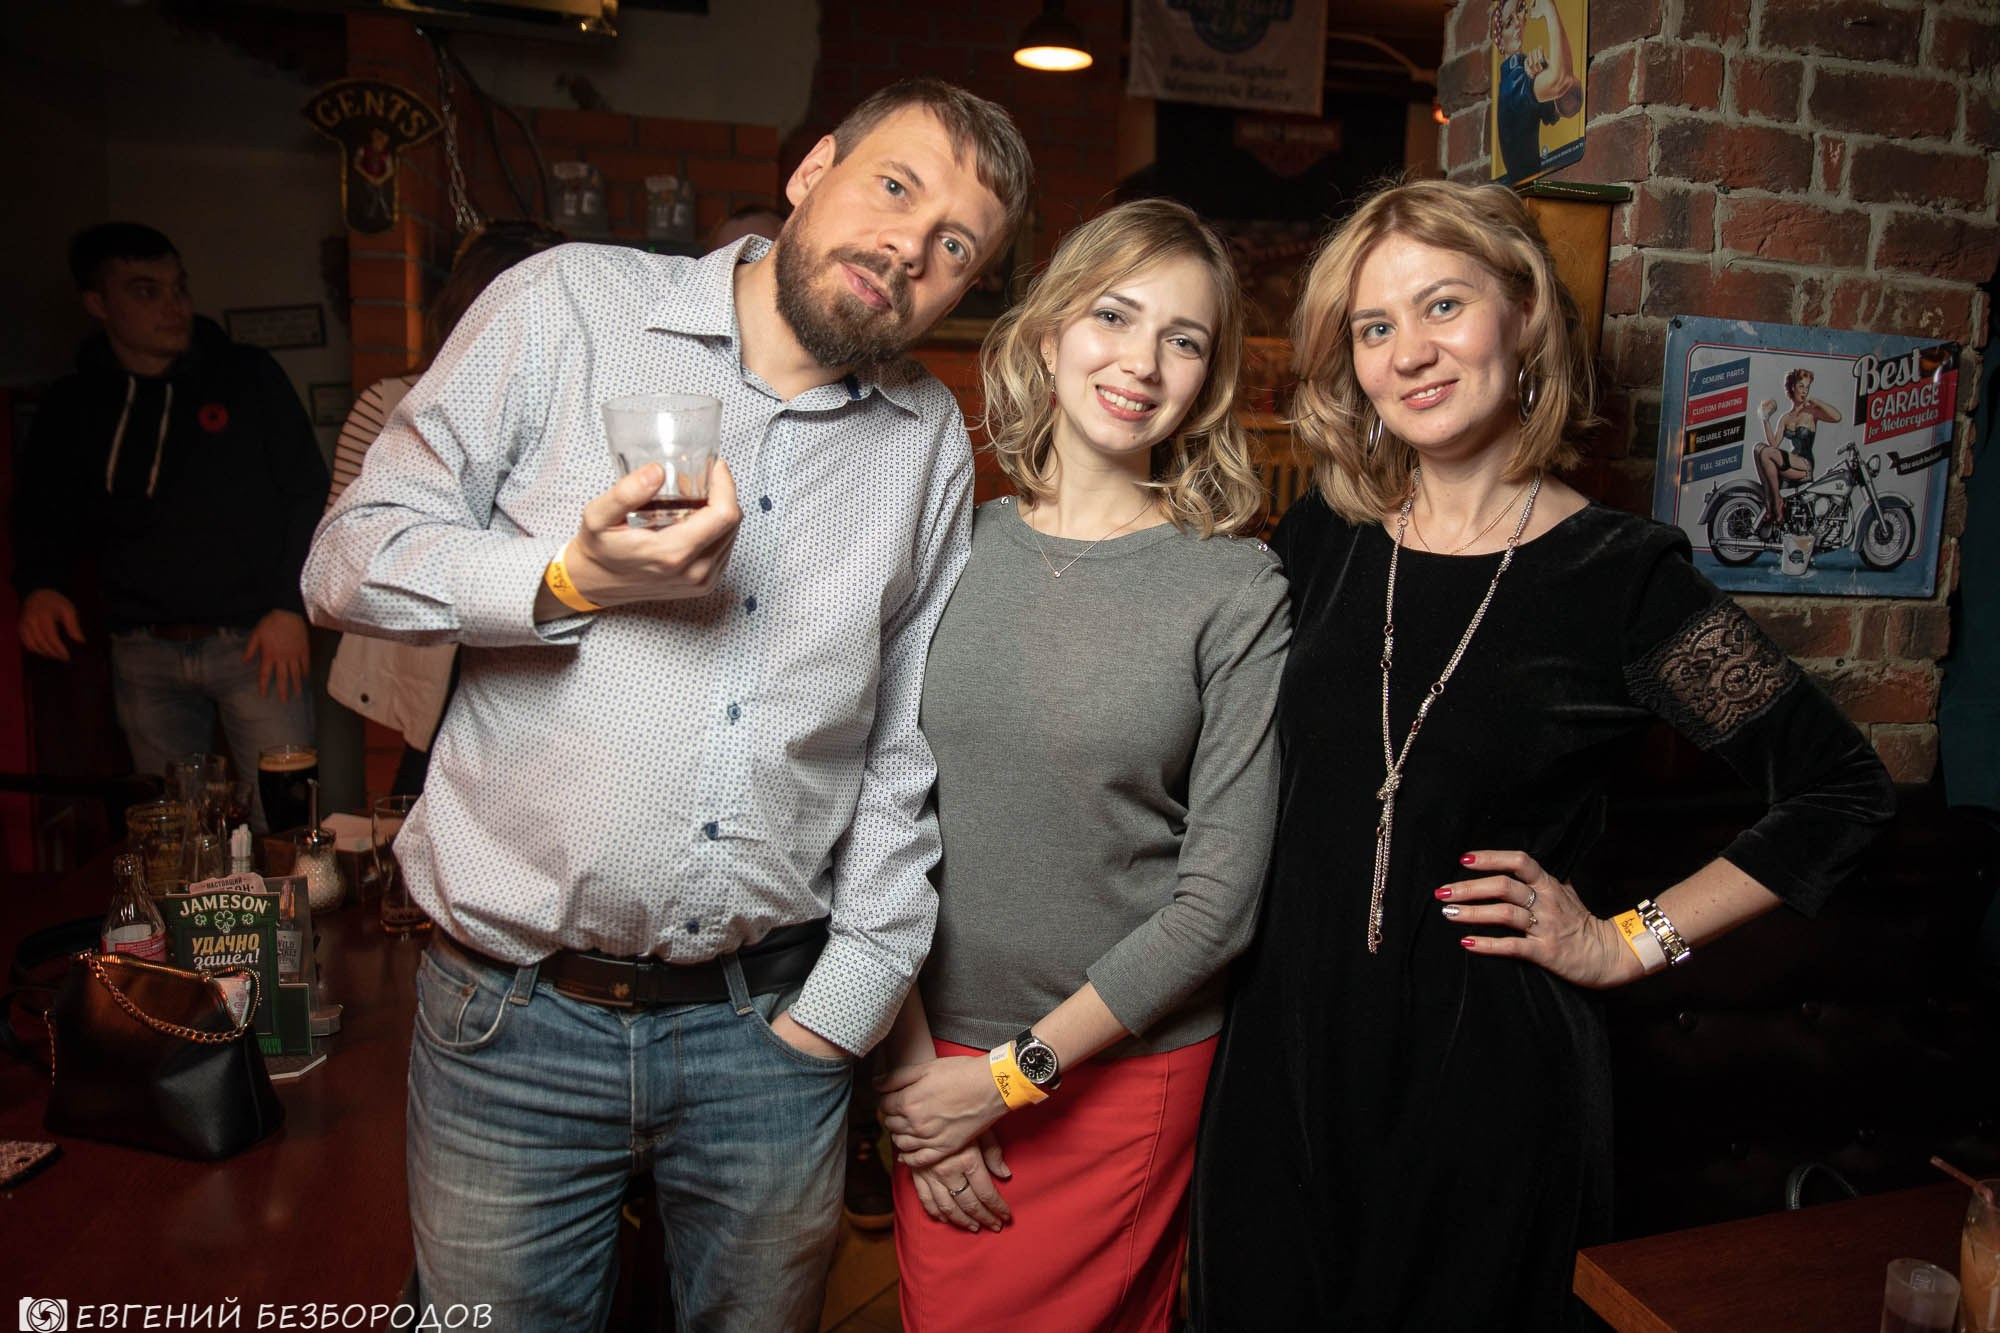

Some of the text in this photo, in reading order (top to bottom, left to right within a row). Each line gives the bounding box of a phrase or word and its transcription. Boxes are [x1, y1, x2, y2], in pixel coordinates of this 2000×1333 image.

[315, 89, 428, 137] GENTS
[1701, 368, 1745, 384] GENUINE PARTS
[1853, 346, 1921, 397] Best
[1692, 397, 1743, 416] CUSTOM PAINTING
[1870, 383, 1940, 420] GARAGE
[1880, 408, 1940, 434] Motorcycles
[1696, 426, 1742, 444] RELIABLE STAFF
[1714, 455, 1738, 468] SERVICE
[179, 893, 268, 917] JAMESON
[192, 933, 260, 955] УДАЧНО
[193, 947, 261, 971] зашёл!
